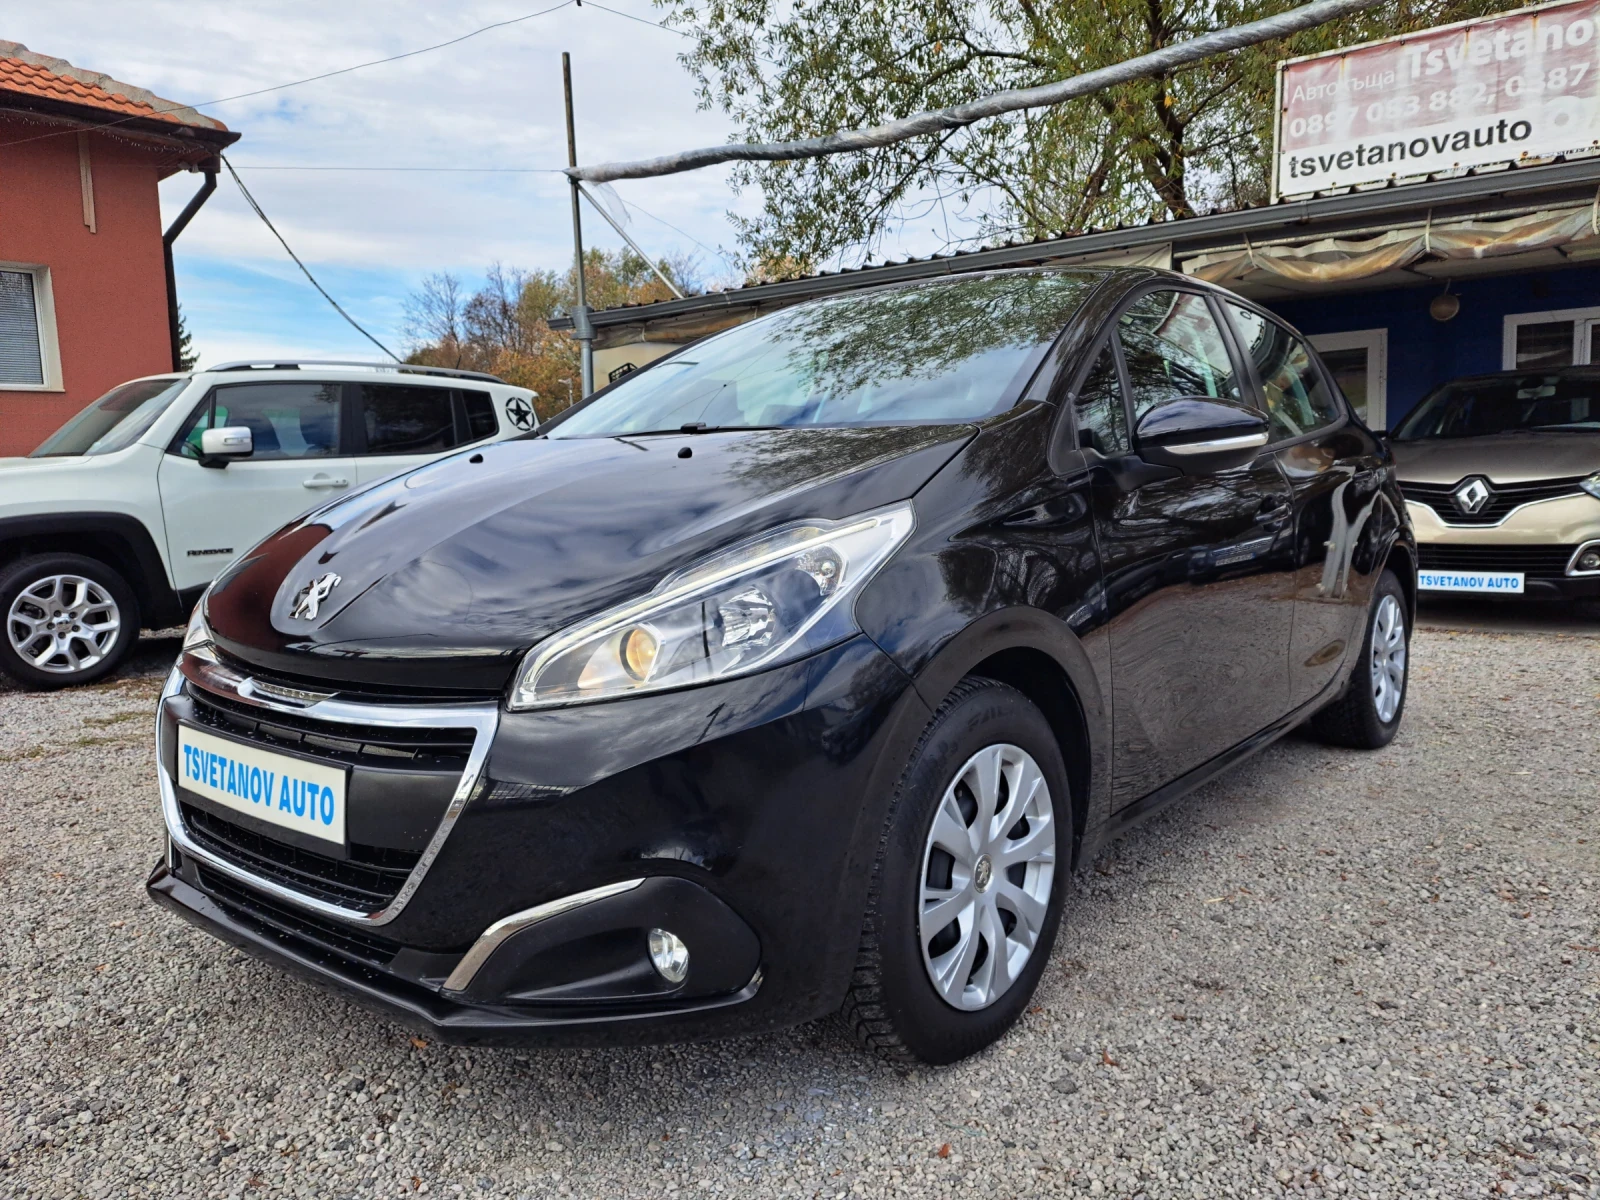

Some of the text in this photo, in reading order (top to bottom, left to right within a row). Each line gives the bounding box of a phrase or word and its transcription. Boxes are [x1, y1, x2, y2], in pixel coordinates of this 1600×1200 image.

[1289, 118, 1532, 178] tsvetanovauto
[1420, 575, 1519, 589] TSVETANOV AUTO
[183, 744, 335, 826] TSVETANOV AUTO
